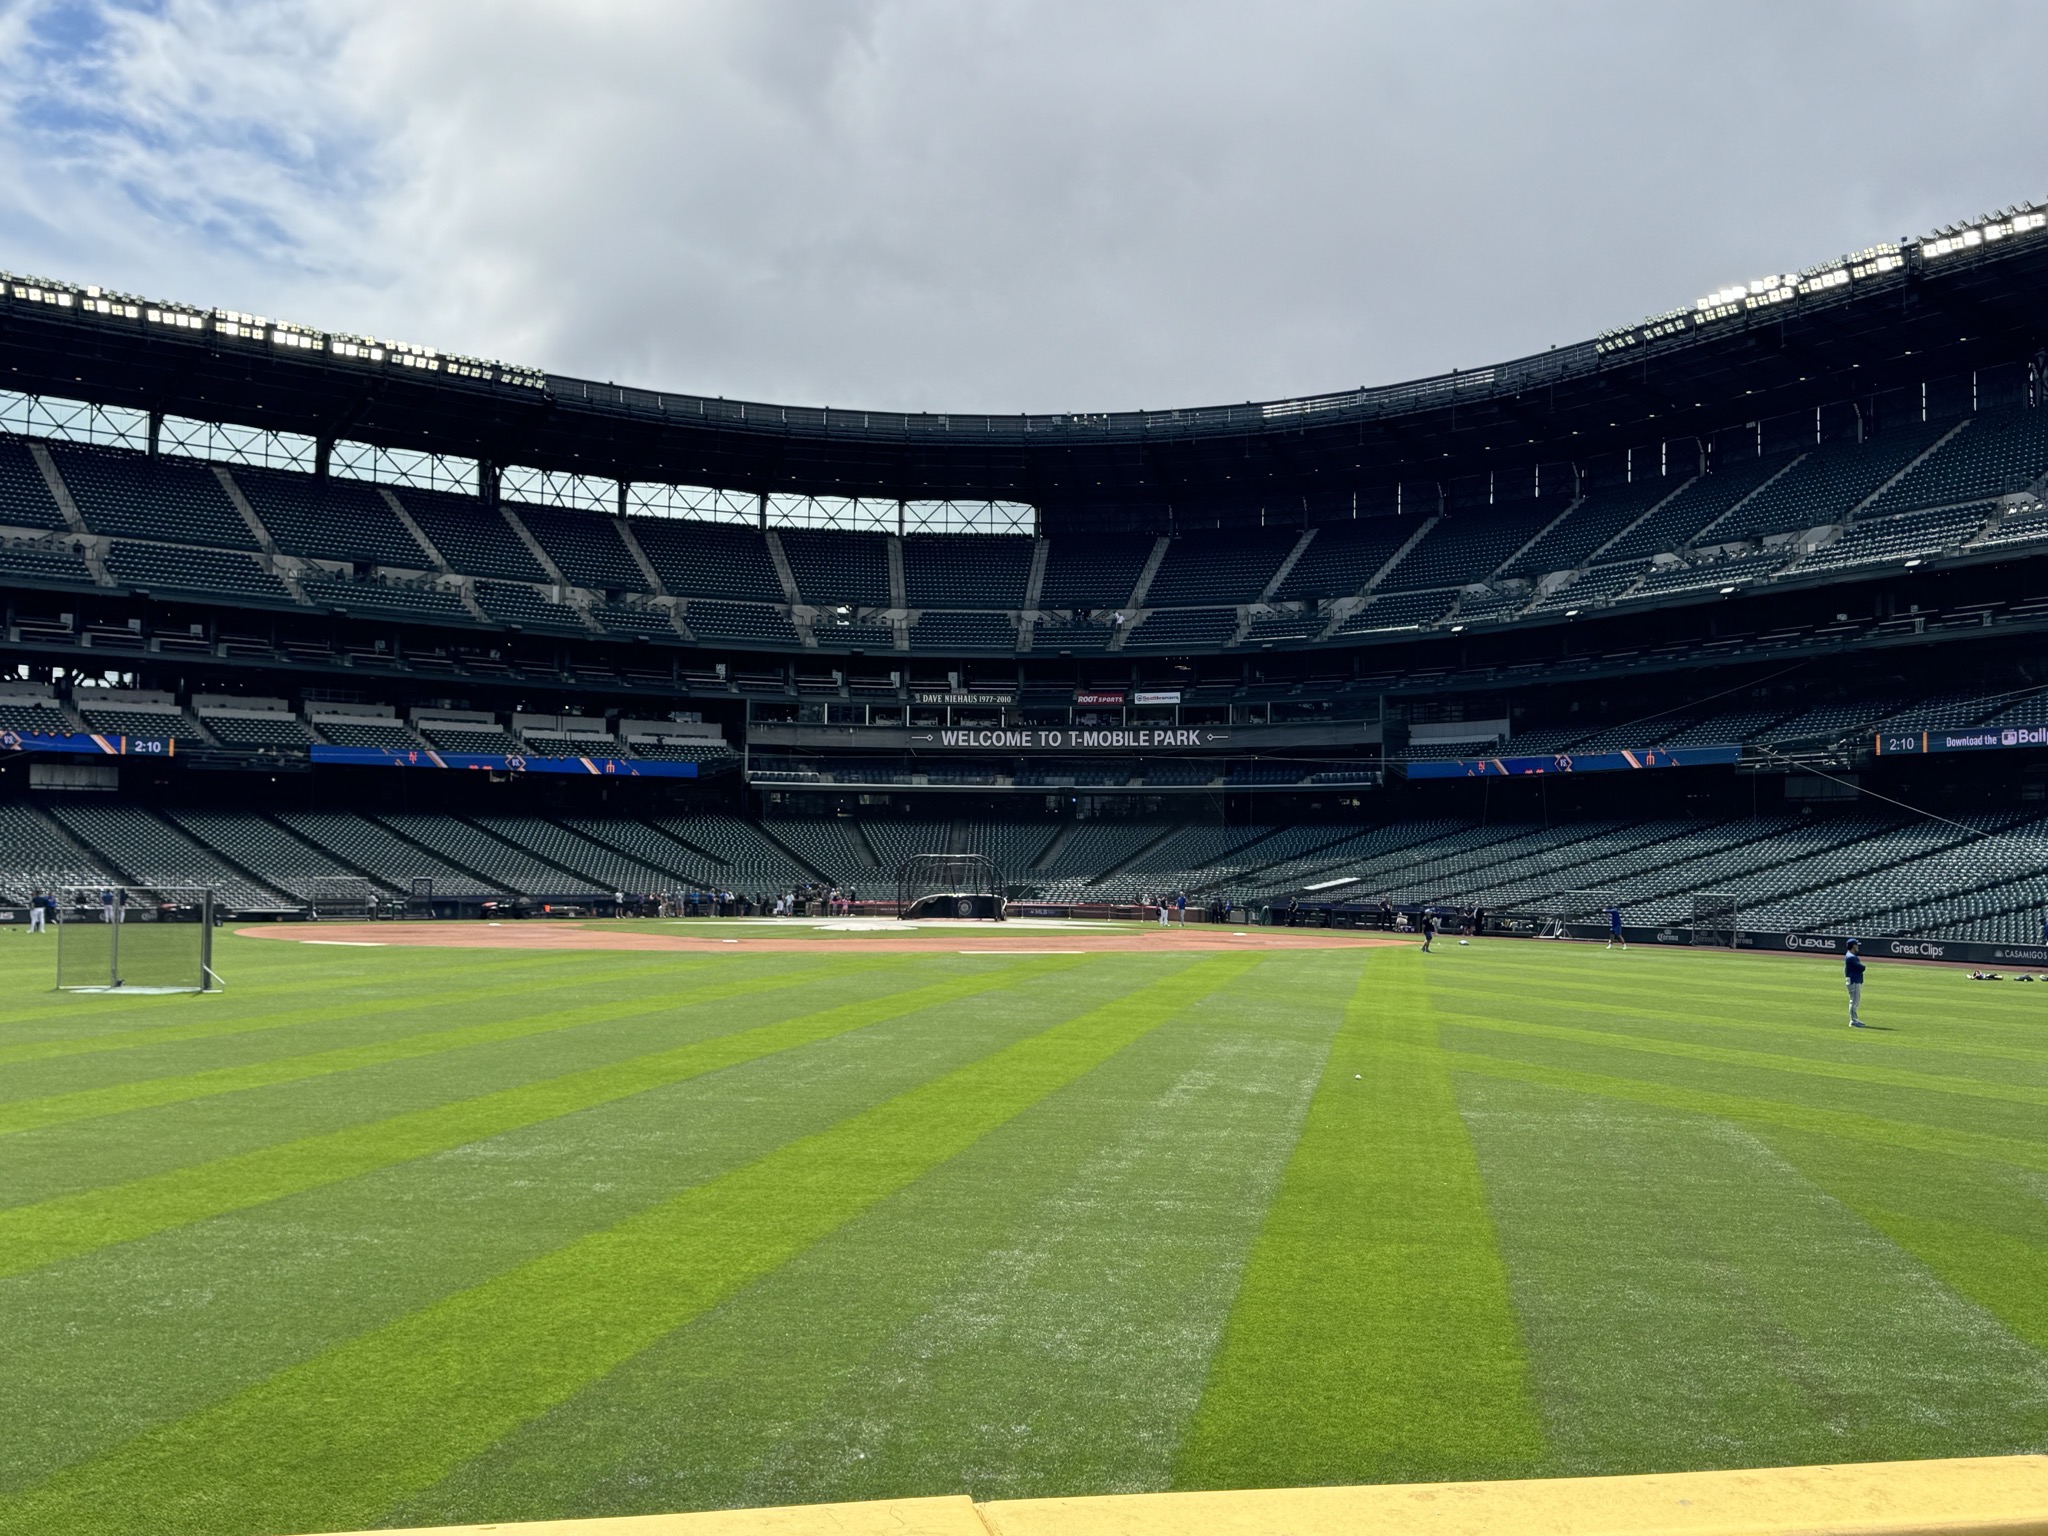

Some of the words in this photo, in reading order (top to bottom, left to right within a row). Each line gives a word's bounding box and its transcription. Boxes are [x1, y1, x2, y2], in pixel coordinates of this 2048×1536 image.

[923, 695, 942, 703] DAVE
[945, 694, 977, 703] NIEHAUS
[979, 695, 1011, 703] 1977-2010
[941, 731, 1032, 747] WELCOME
[1038, 731, 1062, 747] TO
[1068, 730, 1149, 747] T-MOBILE
[1154, 730, 1201, 746] PARK
[1946, 735, 1983, 747] Download
[1984, 735, 1997, 745] the
[2018, 728, 2048, 745] Ball
[135, 741, 161, 752] 2:10
[1890, 738, 1914, 750] 2:10
[1657, 933, 1678, 942] Corona
[1800, 938, 1836, 948] LEXUS
[1890, 941, 1919, 954] Great
[1920, 943, 1944, 958] Clips
[2005, 949, 2047, 960] CASAMIGOS
